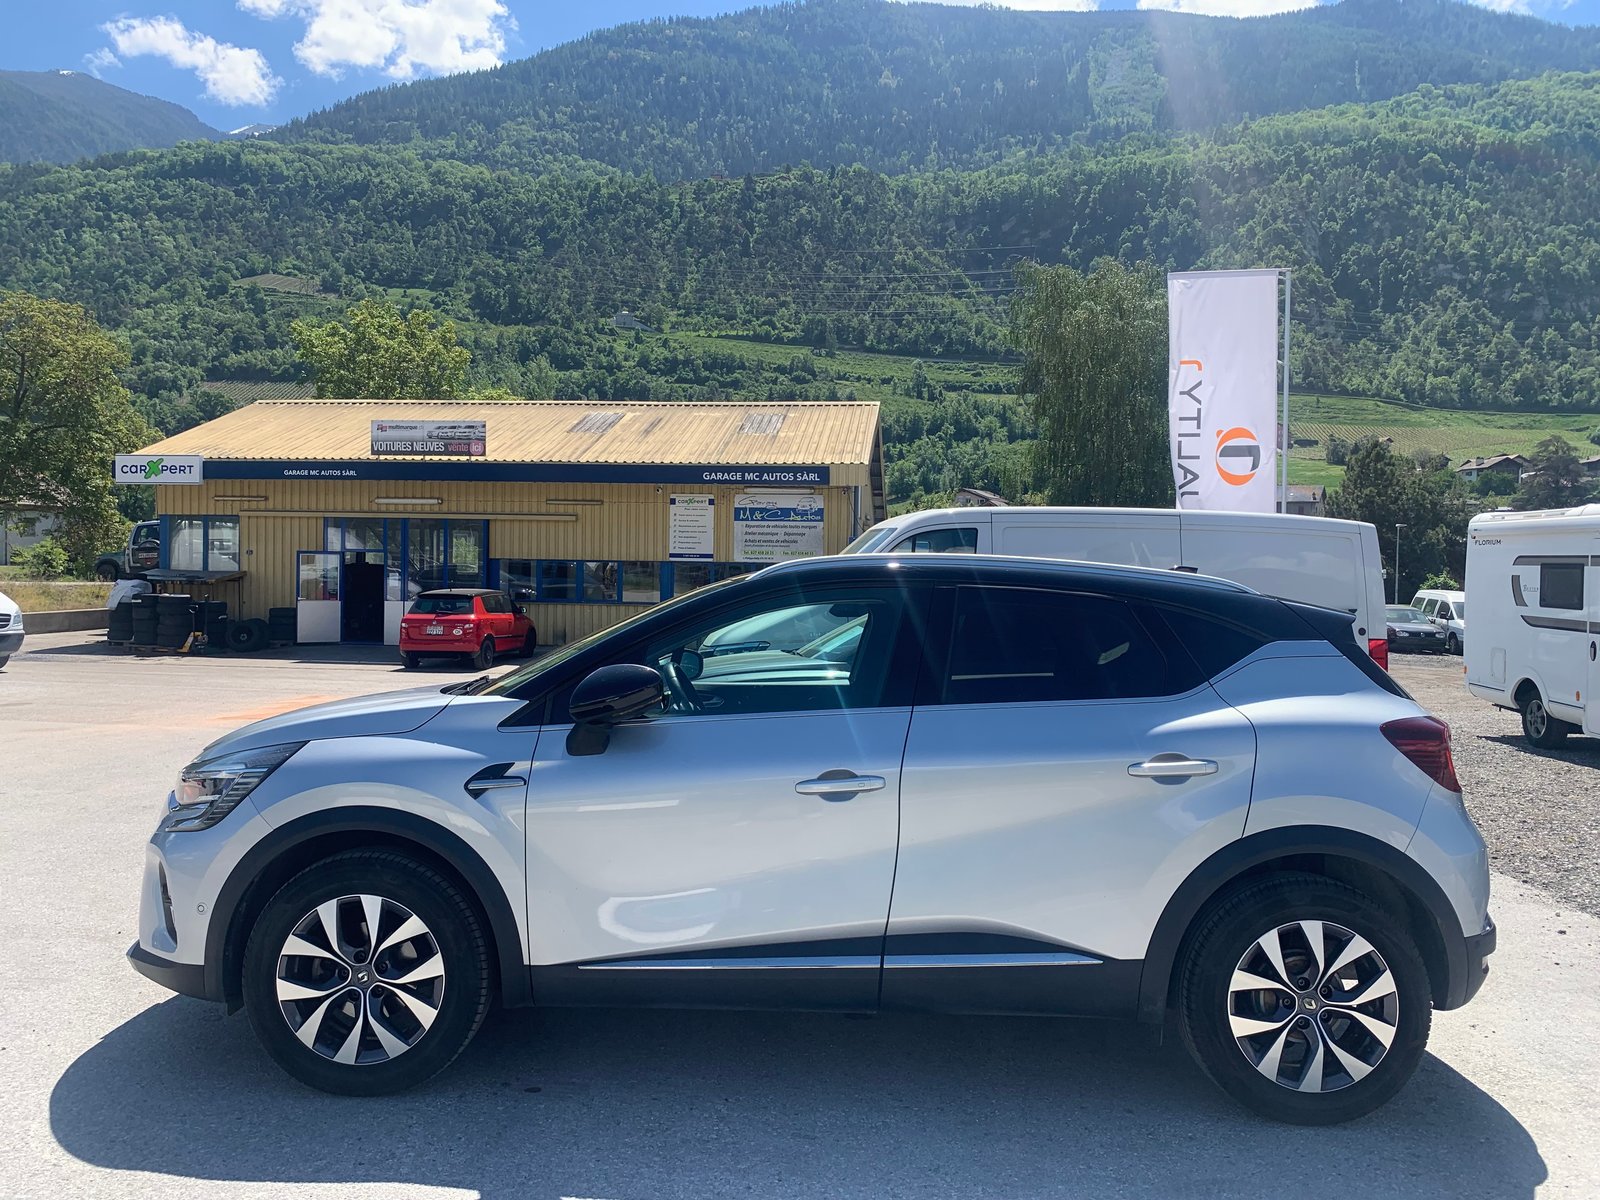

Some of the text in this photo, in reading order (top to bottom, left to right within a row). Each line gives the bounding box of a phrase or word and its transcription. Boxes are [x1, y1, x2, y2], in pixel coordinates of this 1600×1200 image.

[373, 441, 445, 452] VOITURES NEUVES
[448, 443, 469, 452] vente
[283, 469, 308, 477] GARAGE
[309, 469, 320, 477] MC
[320, 469, 341, 477] AUTOS
[703, 472, 743, 482] GARAGE
[744, 472, 760, 482] MC
[762, 472, 794, 482] AUTOS
[740, 507, 751, 521] M
[753, 510, 764, 520] &
[764, 509, 784, 520] C
